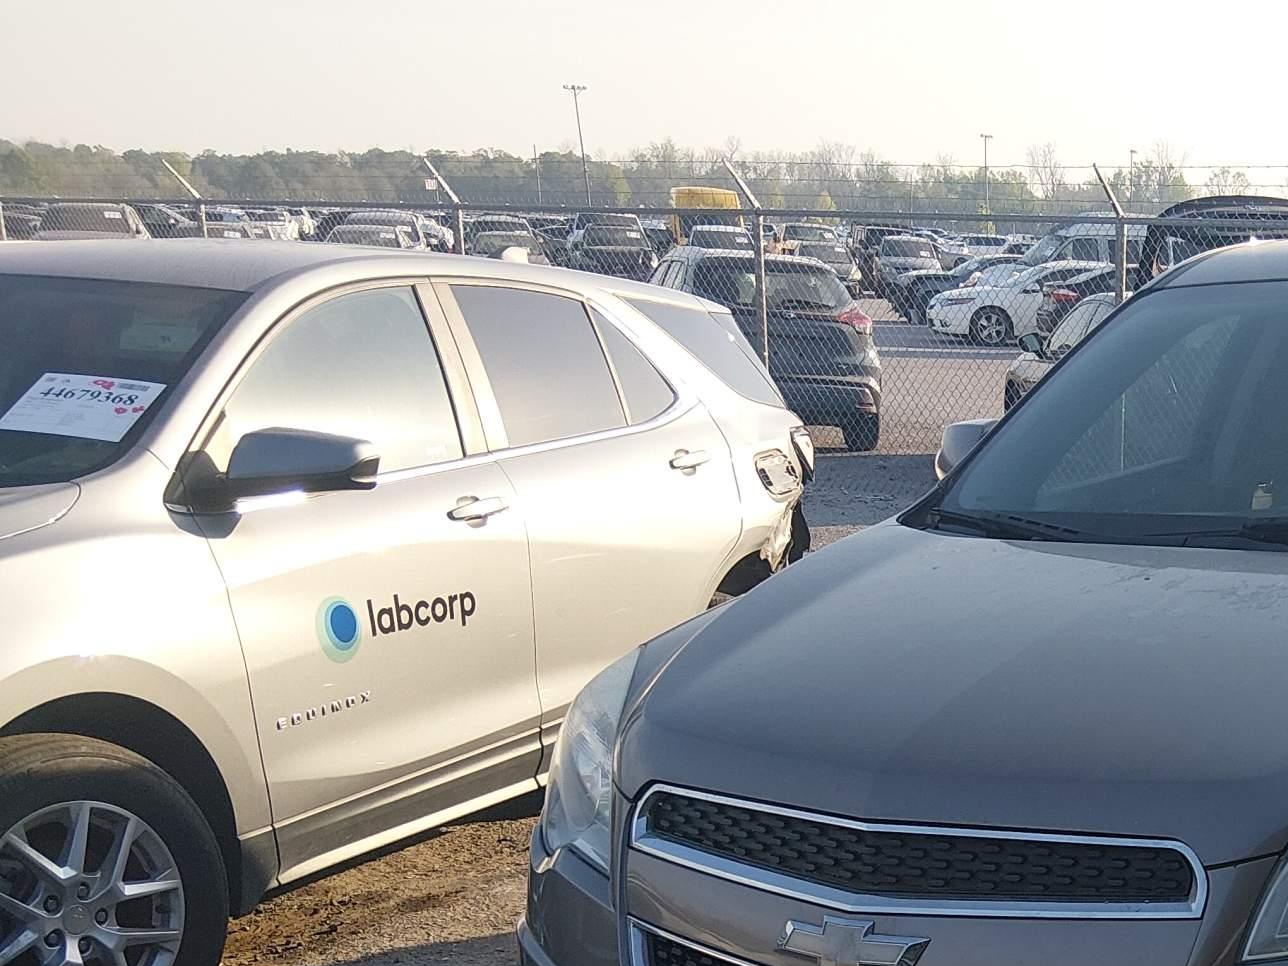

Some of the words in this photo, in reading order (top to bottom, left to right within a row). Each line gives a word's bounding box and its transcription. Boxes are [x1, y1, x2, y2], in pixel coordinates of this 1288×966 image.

[40, 386, 139, 406] 44679368
[367, 591, 476, 637] labcorp
[276, 690, 371, 730] EQUINOX
